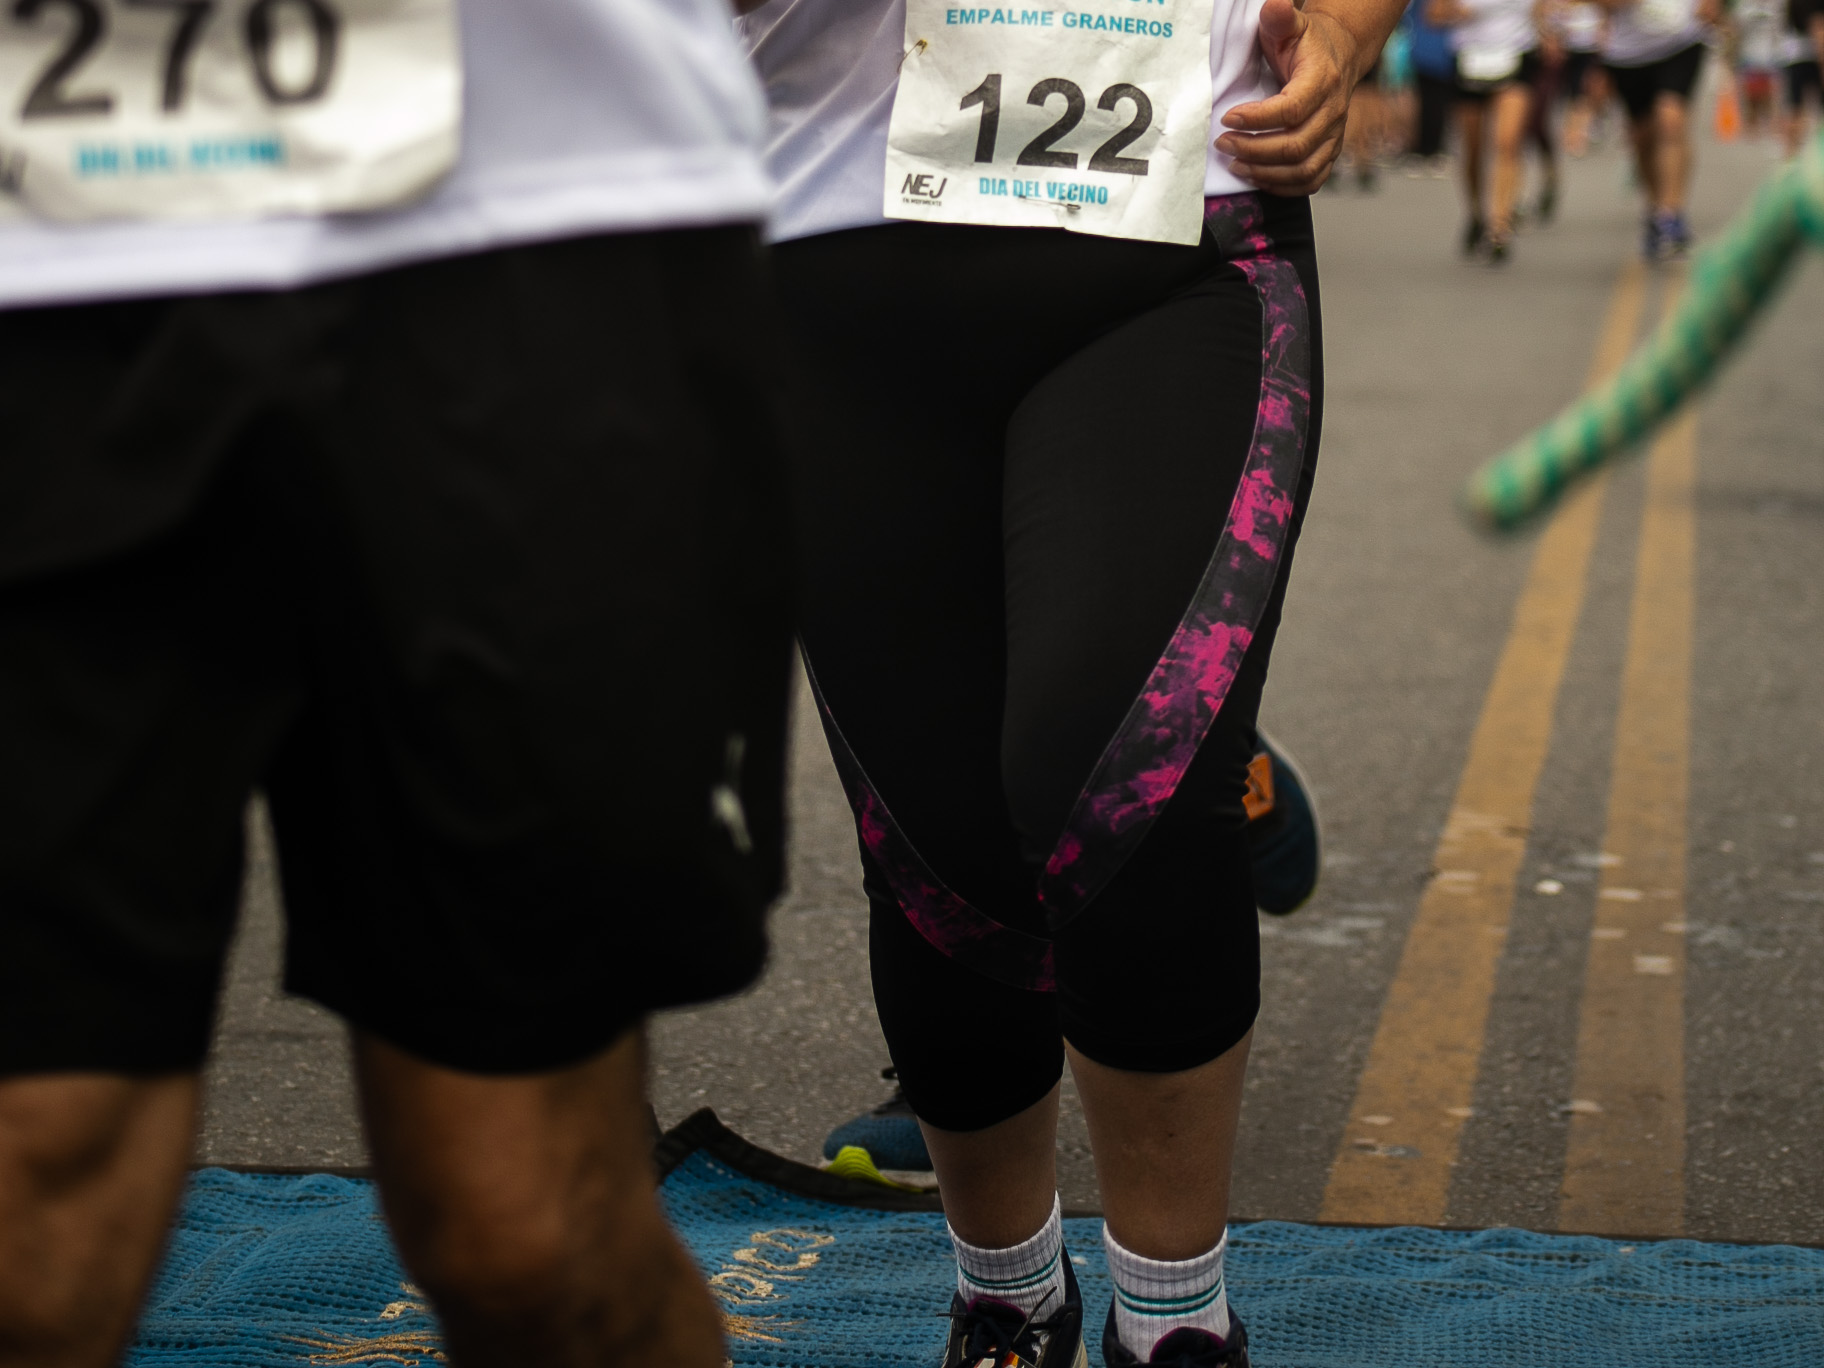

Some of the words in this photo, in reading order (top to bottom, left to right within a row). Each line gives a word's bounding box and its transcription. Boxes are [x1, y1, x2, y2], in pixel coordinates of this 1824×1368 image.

[946, 8, 1054, 26] EMPALME
[1062, 12, 1173, 38] GRANEROS
[959, 73, 1153, 176] 122
[901, 173, 948, 199] NEJ
[979, 177, 1010, 196] DIA
[1013, 178, 1041, 198] DEL
[1046, 181, 1108, 205] VECINO
